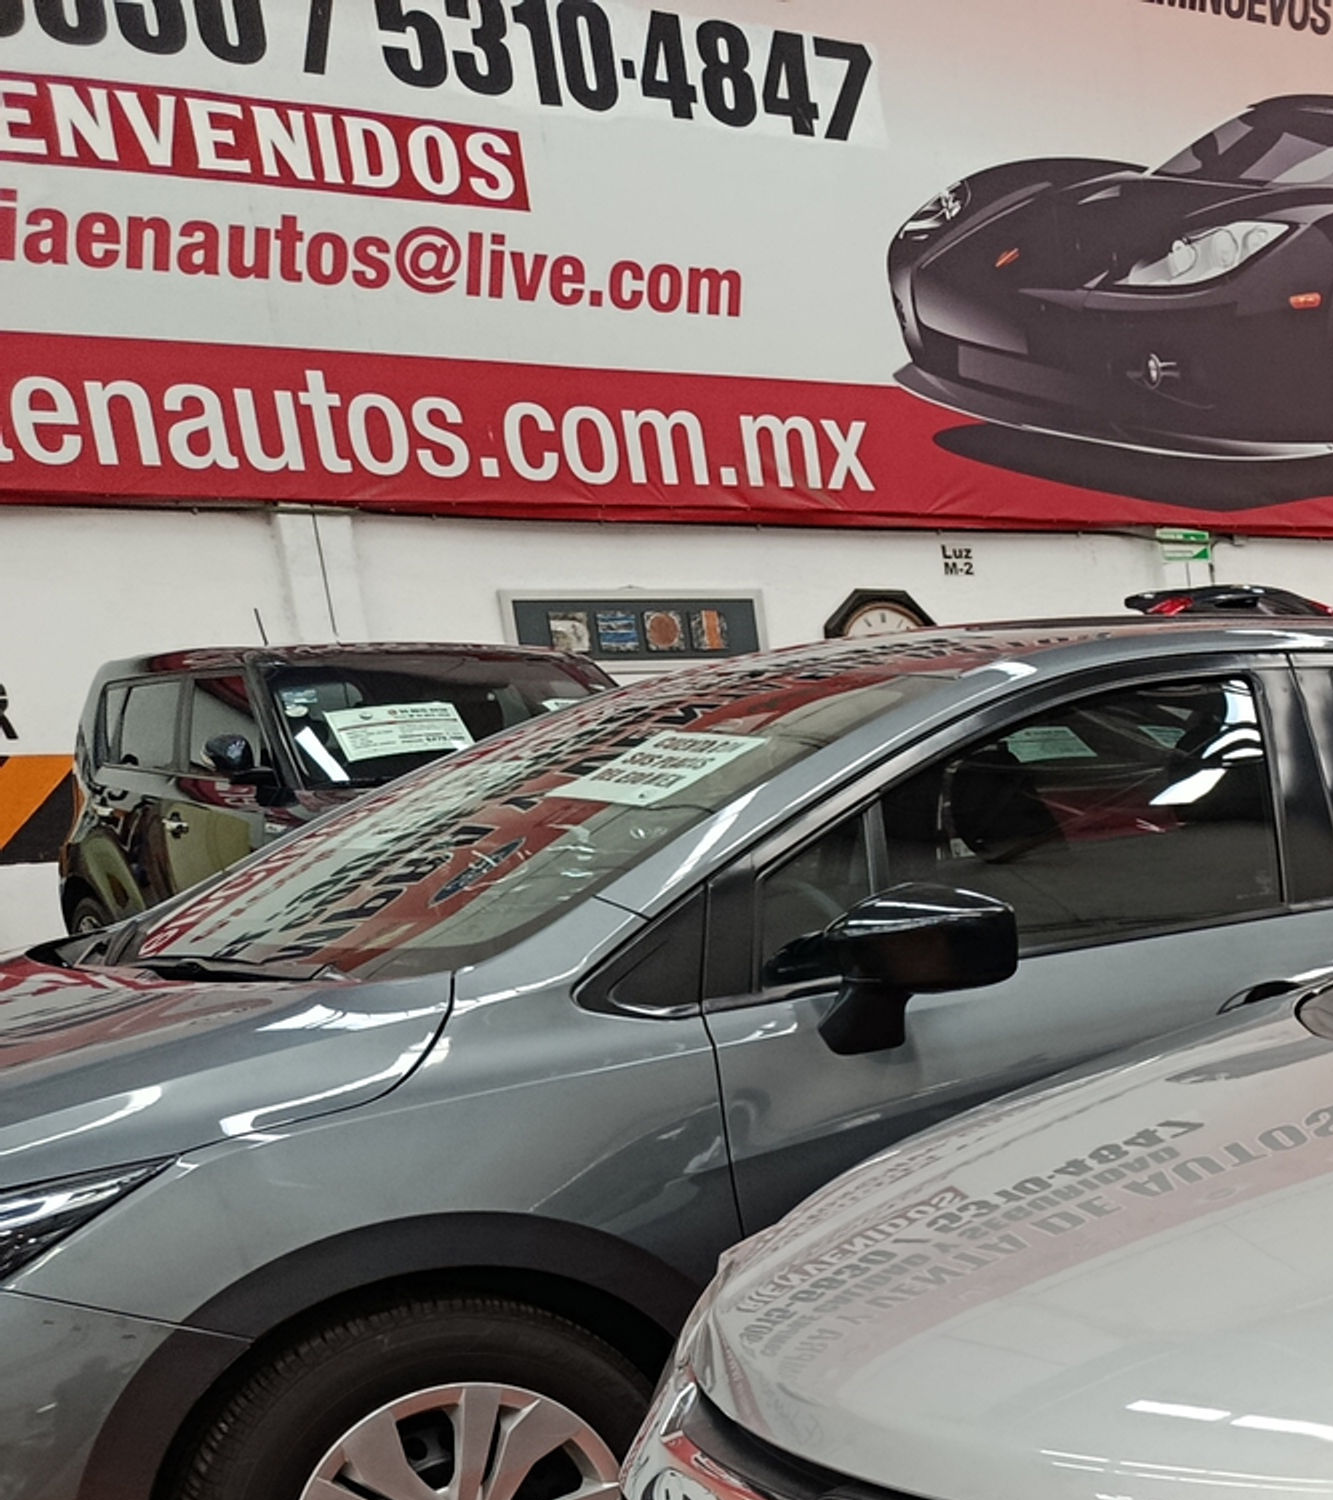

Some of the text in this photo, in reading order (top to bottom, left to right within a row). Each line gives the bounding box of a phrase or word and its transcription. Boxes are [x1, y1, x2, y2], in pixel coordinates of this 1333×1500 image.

[376, 0, 873, 142] 5310-4847
[0, 370, 876, 492] enautos.com.mx
[941, 544, 973, 560] Luz
[943, 562, 975, 576] M-2
